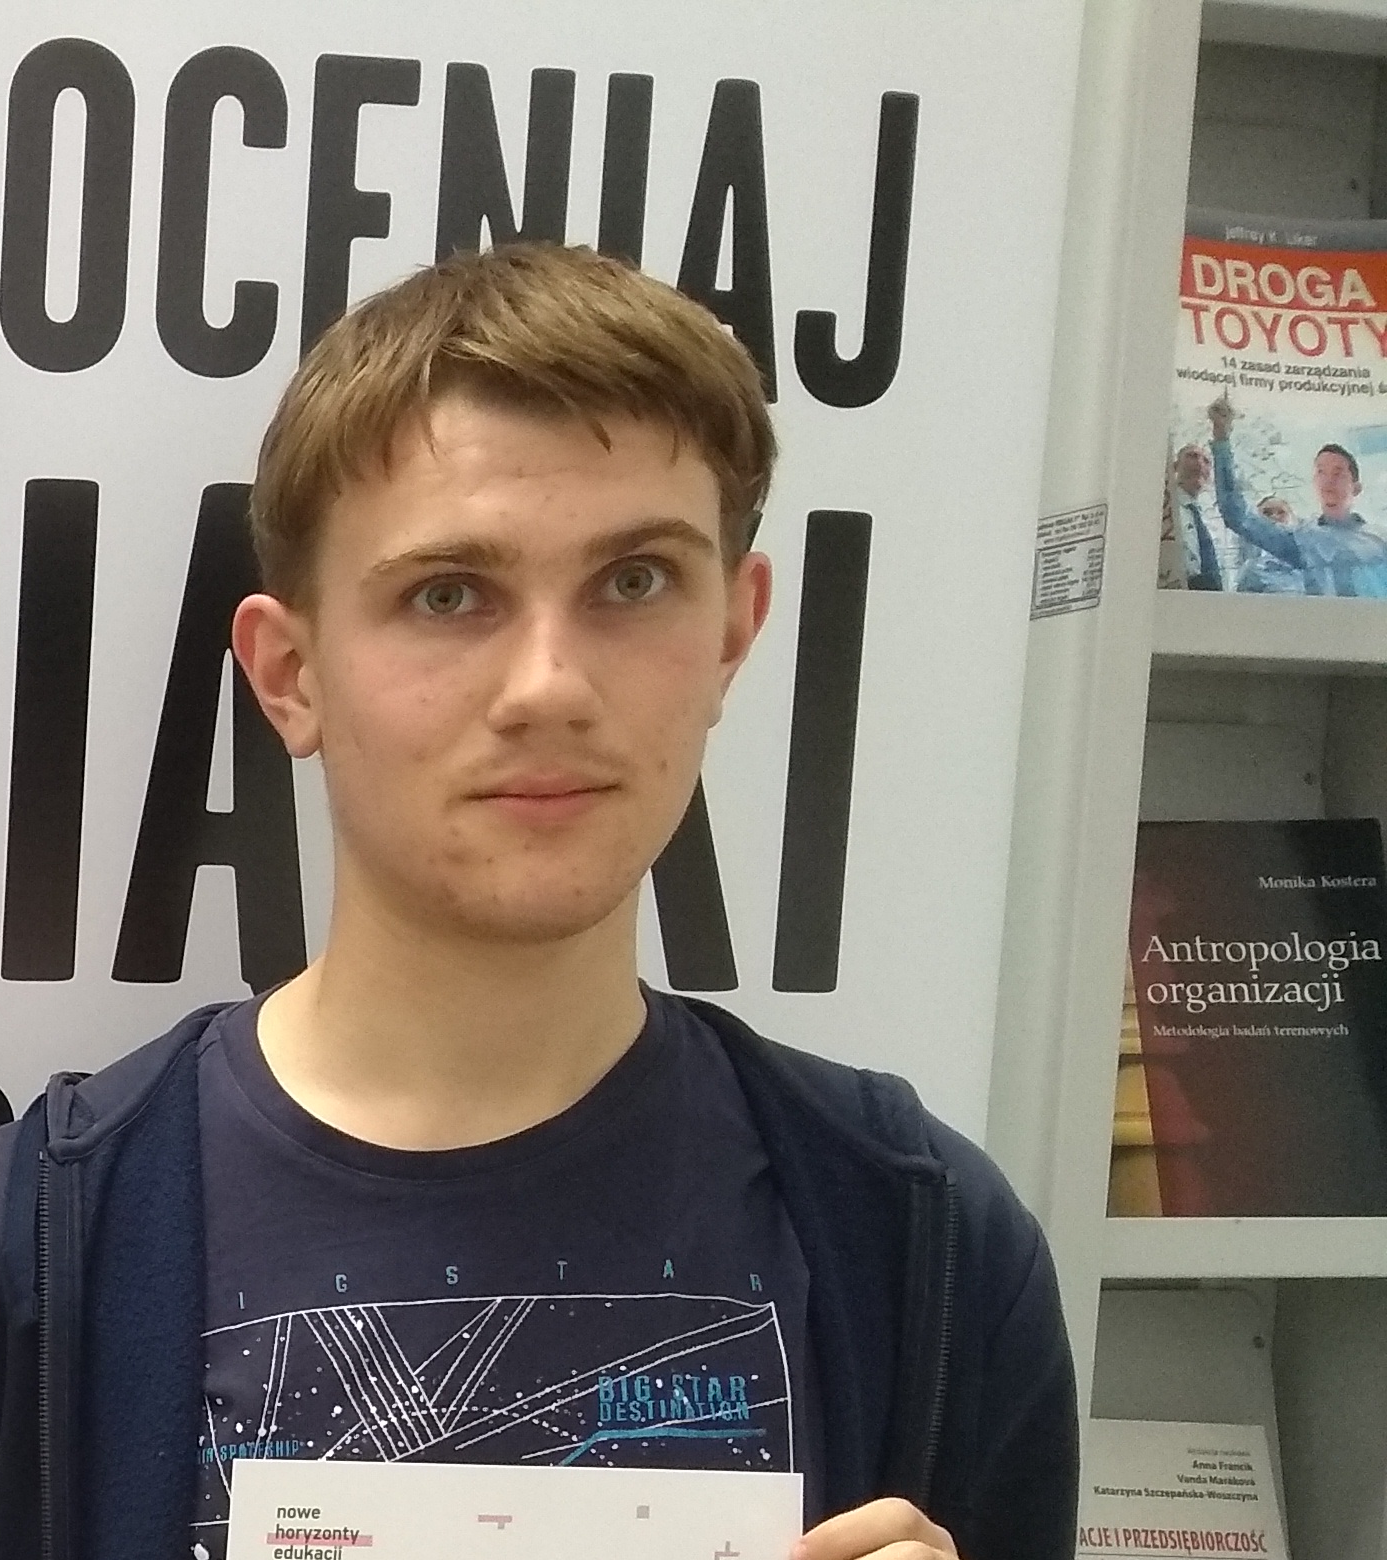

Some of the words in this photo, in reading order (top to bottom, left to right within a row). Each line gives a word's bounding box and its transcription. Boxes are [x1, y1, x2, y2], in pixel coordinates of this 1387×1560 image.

[1191, 253, 1377, 308] DROGA
[1181, 301, 1387, 358] TOYOTY
[1221, 356, 1237, 369] 14
[1241, 359, 1281, 374] zasad
[1284, 363, 1371, 379] zarządzania
[1240, 374, 1275, 391] firmy
[1278, 378, 1374, 397] produkcyjnej
[1258, 876, 1316, 890] Monika
[1320, 874, 1376, 888] Kostera
[1141, 931, 1382, 972] Antropologia
[1146, 973, 1345, 1014] organizacji
[1153, 1023, 1230, 1038] Metodologia
[1233, 1023, 1272, 1037] badań
[1274, 1023, 1349, 1038] terenowych
[598, 1375, 651, 1403] BIG
[671, 1374, 746, 1402] STAR
[599, 1399, 750, 1422] DESTINATION
[1192, 1460, 1217, 1471] Anna
[1093, 1486, 1142, 1499] Katarzyna
[277, 1505, 321, 1520] nowe
[275, 1524, 359, 1545] horyzonty
[1124, 1528, 1268, 1556] PRZEDSIĘBIORCZOŚĆ
